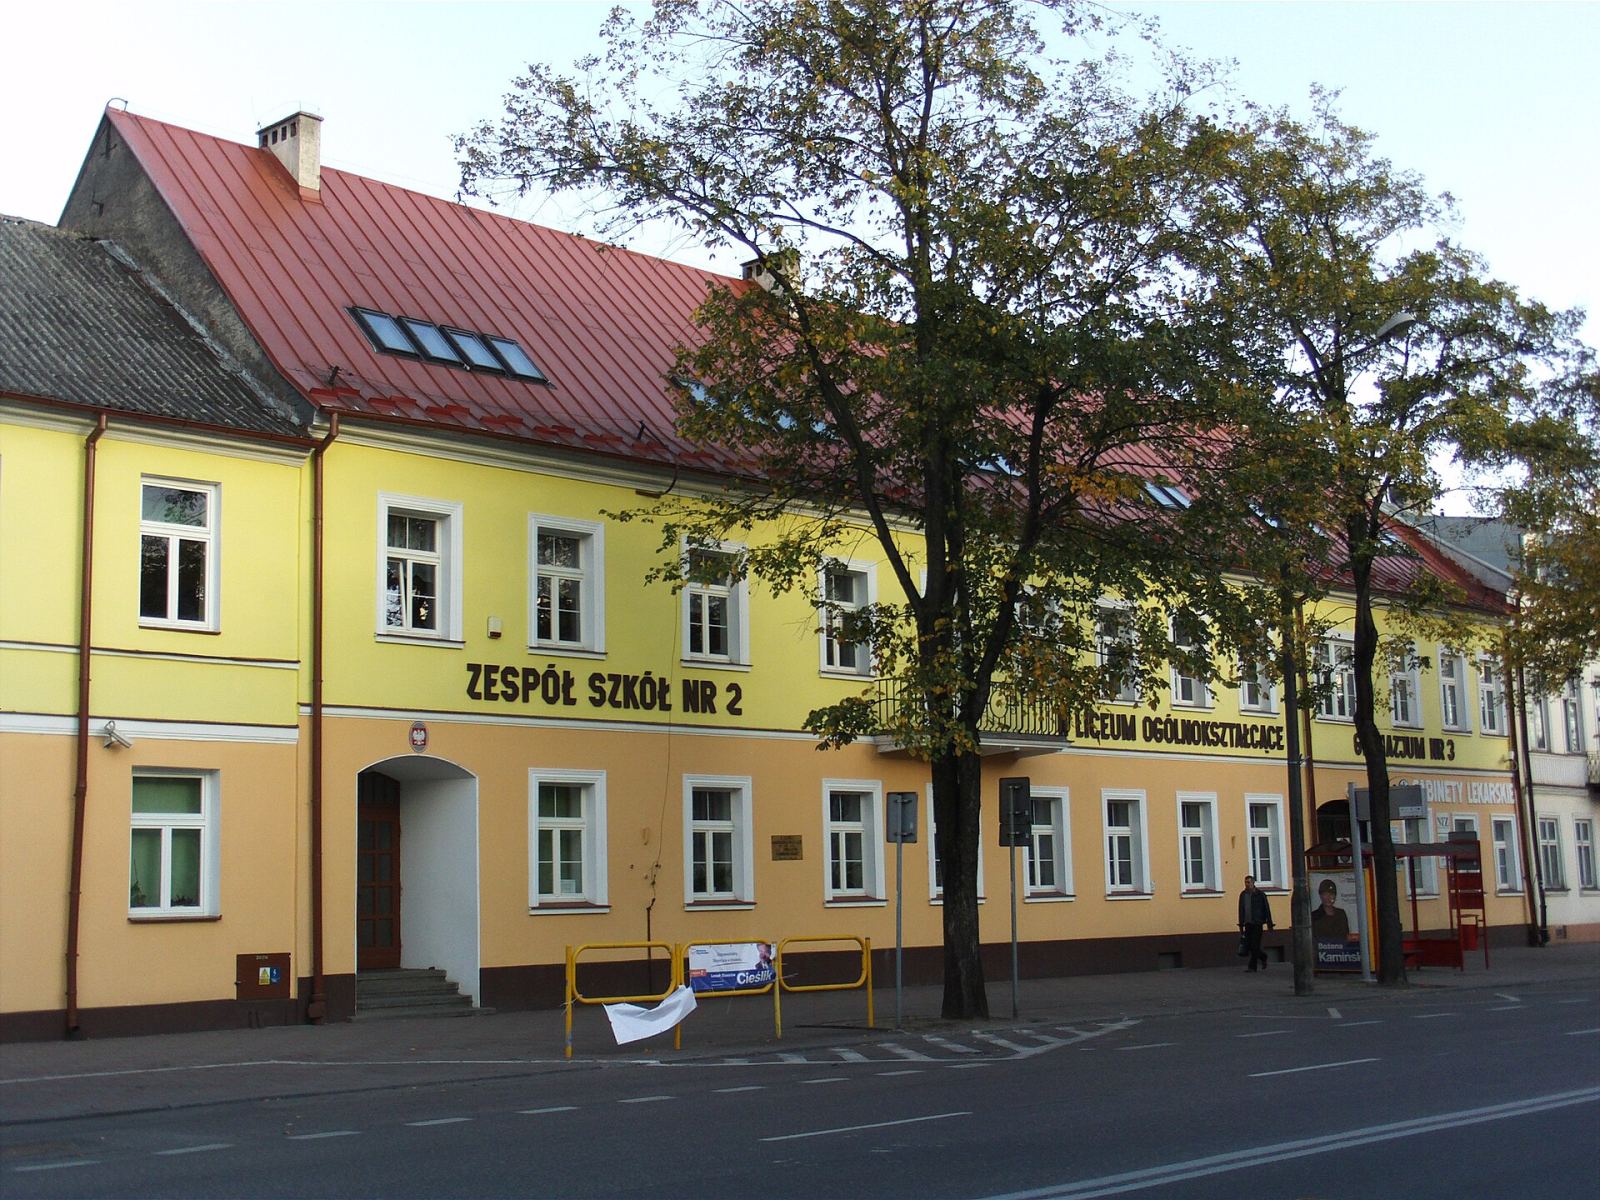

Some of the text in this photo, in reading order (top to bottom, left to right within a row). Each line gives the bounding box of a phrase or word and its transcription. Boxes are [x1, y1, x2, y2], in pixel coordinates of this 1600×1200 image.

[466, 663, 743, 716] ZESPÓŁ SZKÓŁ NR 2
[1075, 710, 1284, 753] LICEUM OGÓLNOKSZTAŁCĄCE
[1353, 733, 1456, 761] GAZJUM NR 3
[1467, 782, 1515, 804] LEKARSKIE
[737, 970, 773, 985] Cieślik
